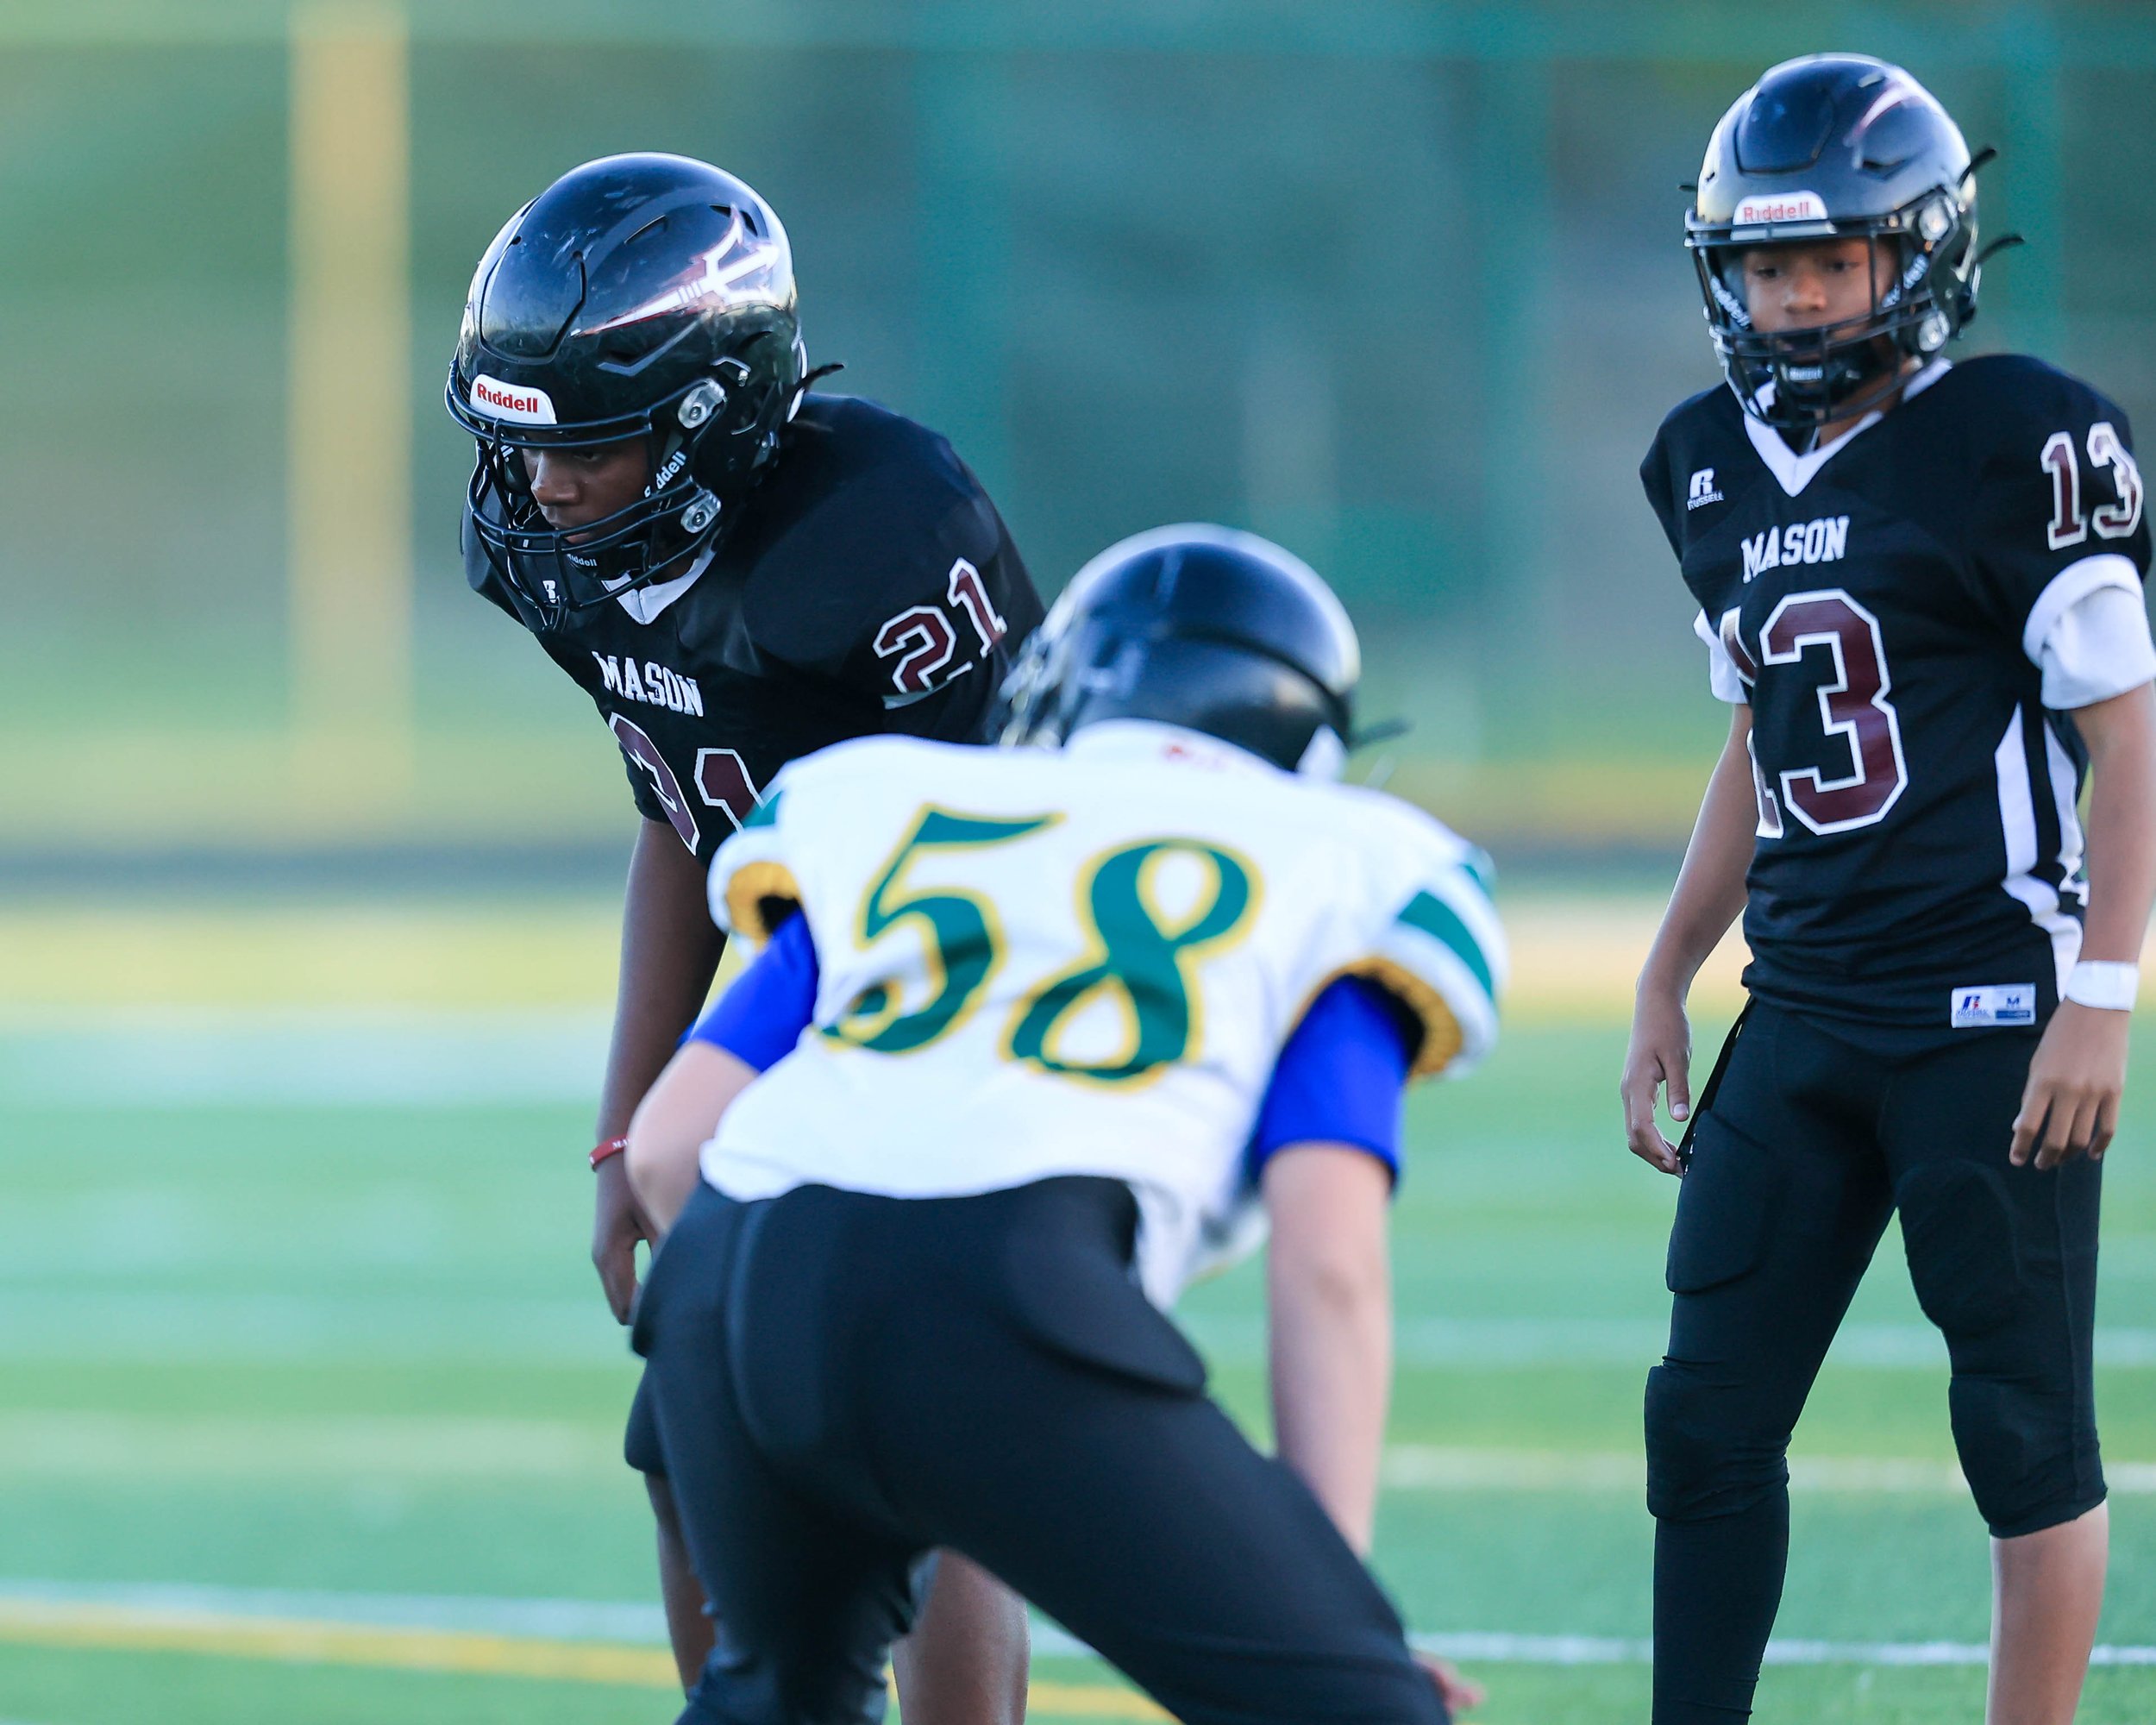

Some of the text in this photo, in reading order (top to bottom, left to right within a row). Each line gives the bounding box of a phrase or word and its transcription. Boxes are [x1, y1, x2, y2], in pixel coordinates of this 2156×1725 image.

[1744, 202, 1809, 223] Riddell
[477, 383, 538, 413] Riddell
[2041, 422, 2145, 550] 13
[1740, 516, 1850, 583] MASON
[873, 557, 1007, 710] 21
[592, 650, 704, 717] MASON
[814, 802, 1264, 1092] 58
